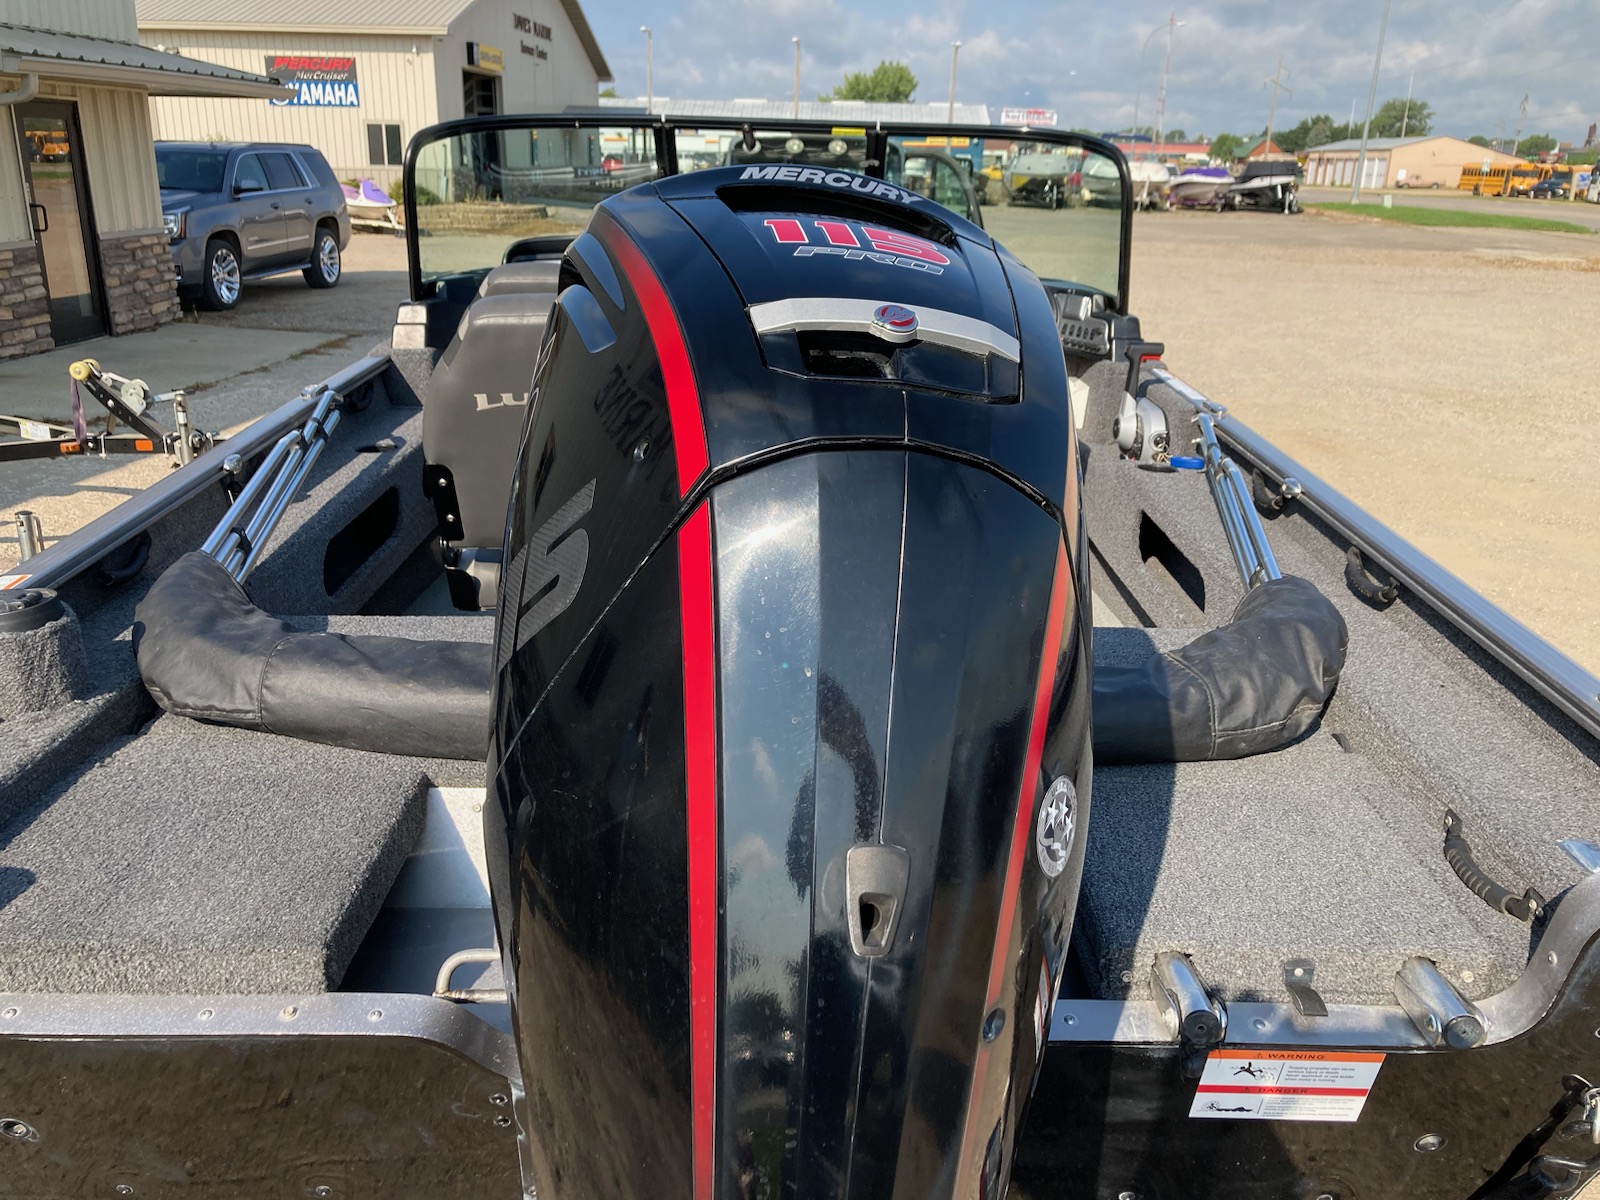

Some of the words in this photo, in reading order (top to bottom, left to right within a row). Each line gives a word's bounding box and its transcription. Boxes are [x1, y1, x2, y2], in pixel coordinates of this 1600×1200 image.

[273, 57, 353, 71] MERCURY
[739, 166, 923, 204] MERCURY
[763, 219, 950, 265] 115
[793, 246, 945, 275] PRO
[474, 393, 529, 411] LU
